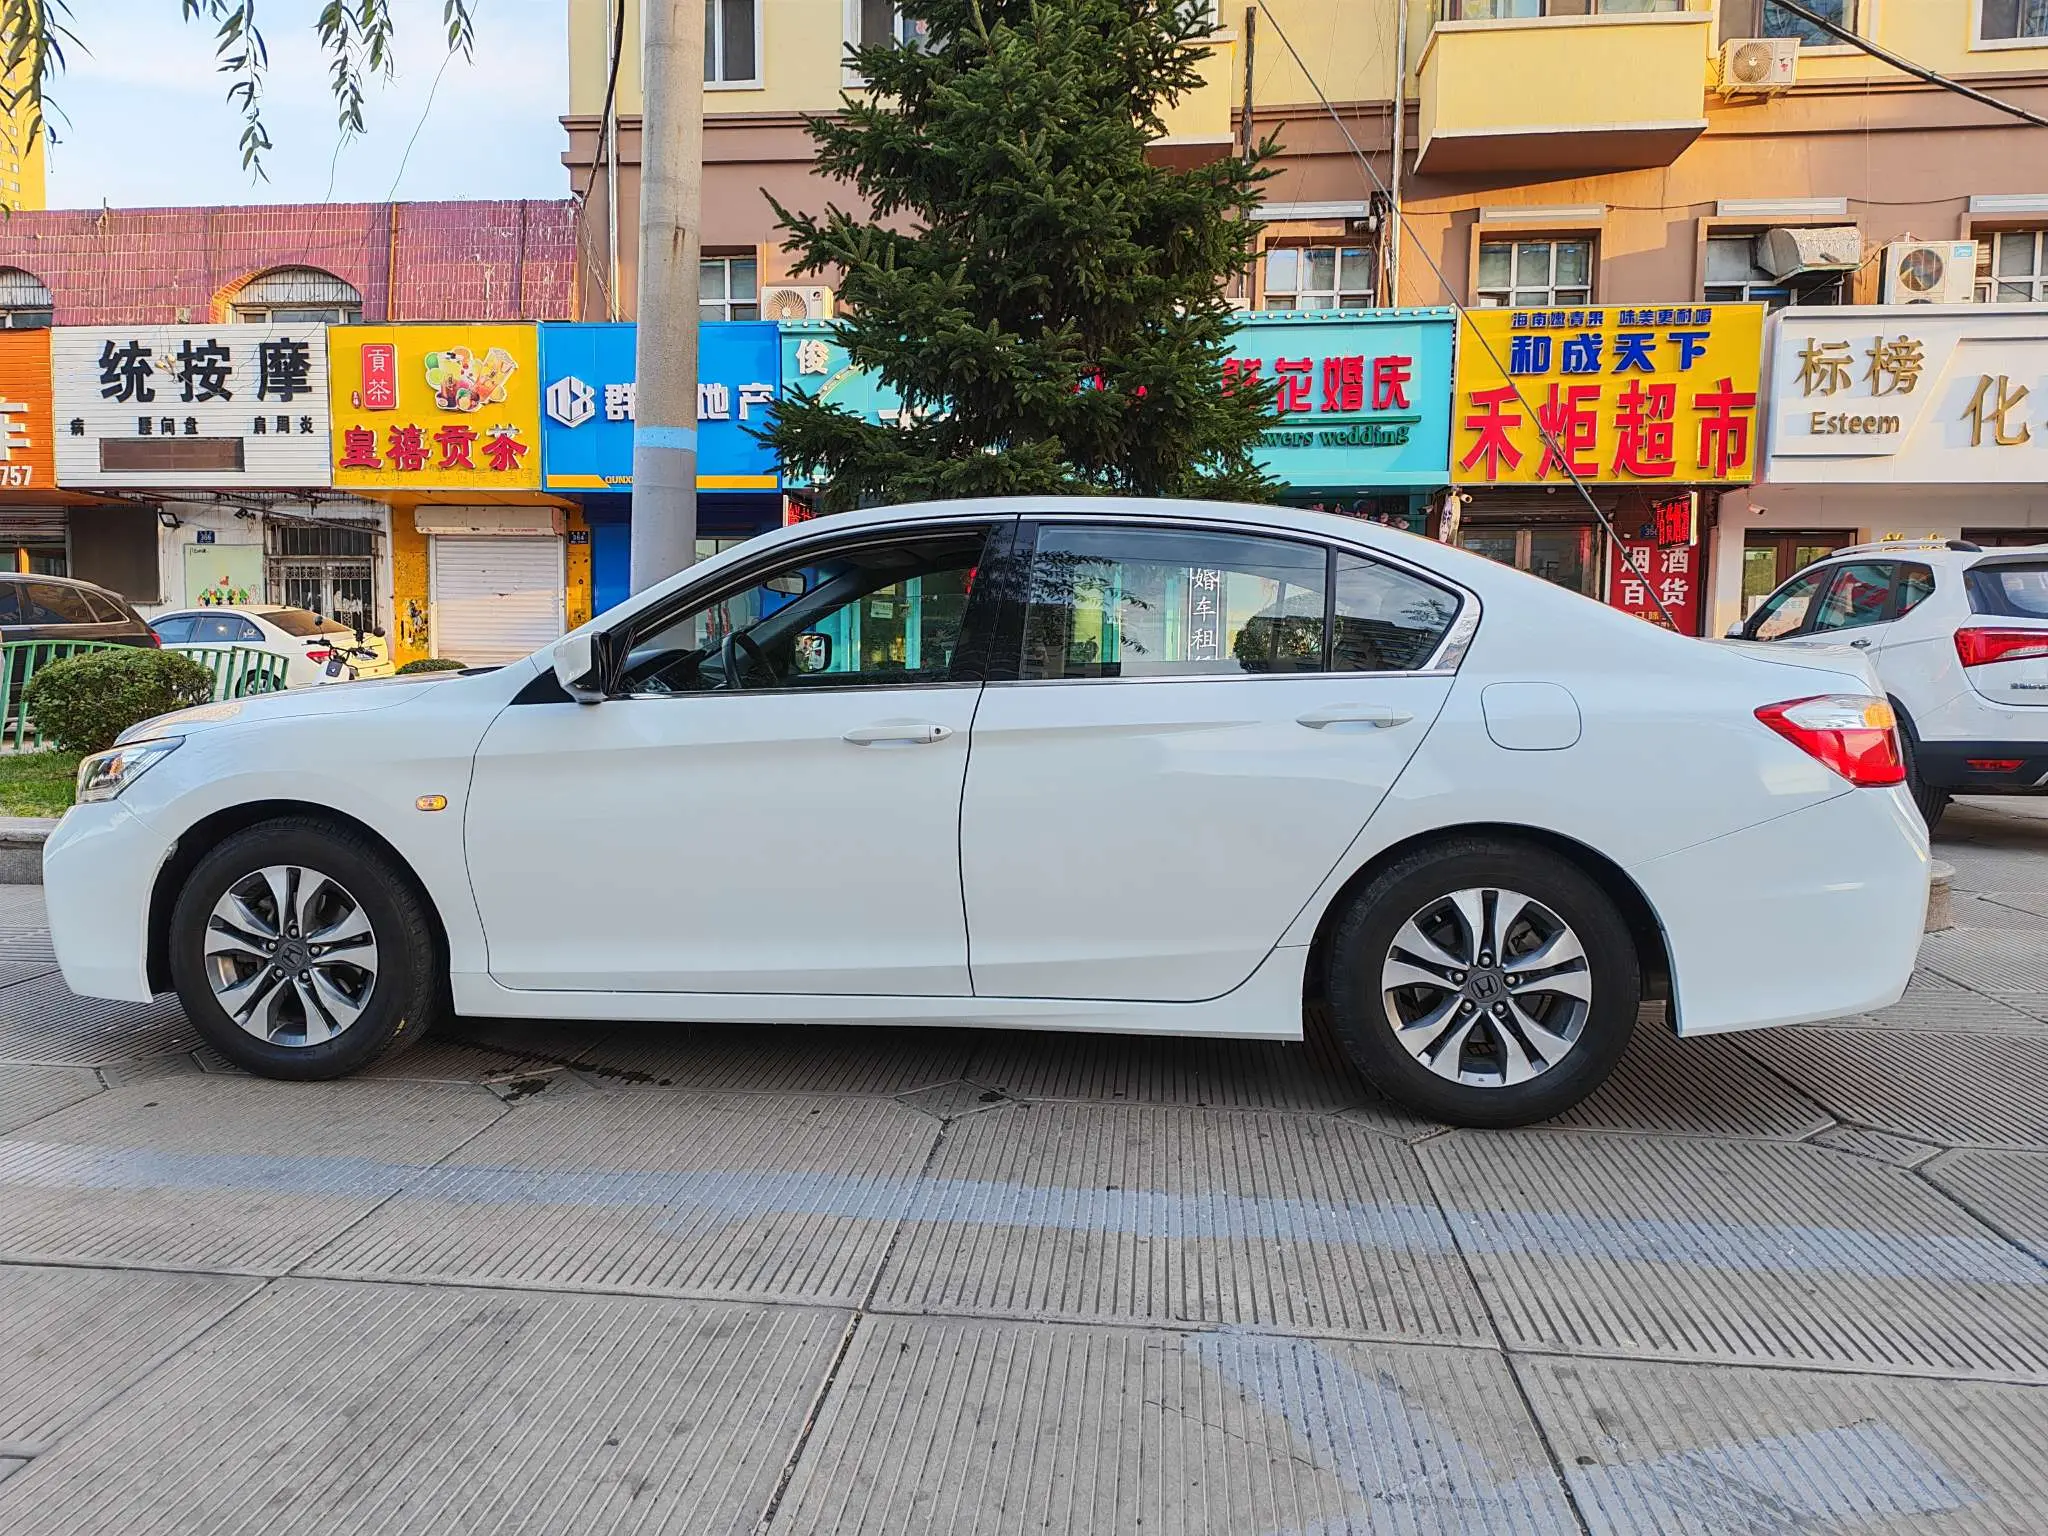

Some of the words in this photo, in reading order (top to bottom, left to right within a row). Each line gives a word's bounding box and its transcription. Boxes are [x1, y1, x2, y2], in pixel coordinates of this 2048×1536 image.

[1512, 310, 1603, 327] 海南嫩青果
[1619, 308, 1711, 326] 味美更耐嚼
[796, 339, 830, 375] 俊
[1510, 331, 1711, 374] 和成天下
[1794, 335, 1925, 397] 标榜
[99, 338, 313, 404] 统按摩
[605, 383, 774, 420] 群地产
[70, 418, 85, 436] 病
[253, 415, 314, 435] 肩周炎
[1319, 424, 1409, 447] wedding
[1460, 377, 1757, 480] 禾炬超市
[1809, 411, 1900, 435] Esteem
[339, 424, 532, 472] 皇禧贡茶
[1620, 546, 1691, 574] 烟酒
[1620, 578, 1689, 606] 百货
